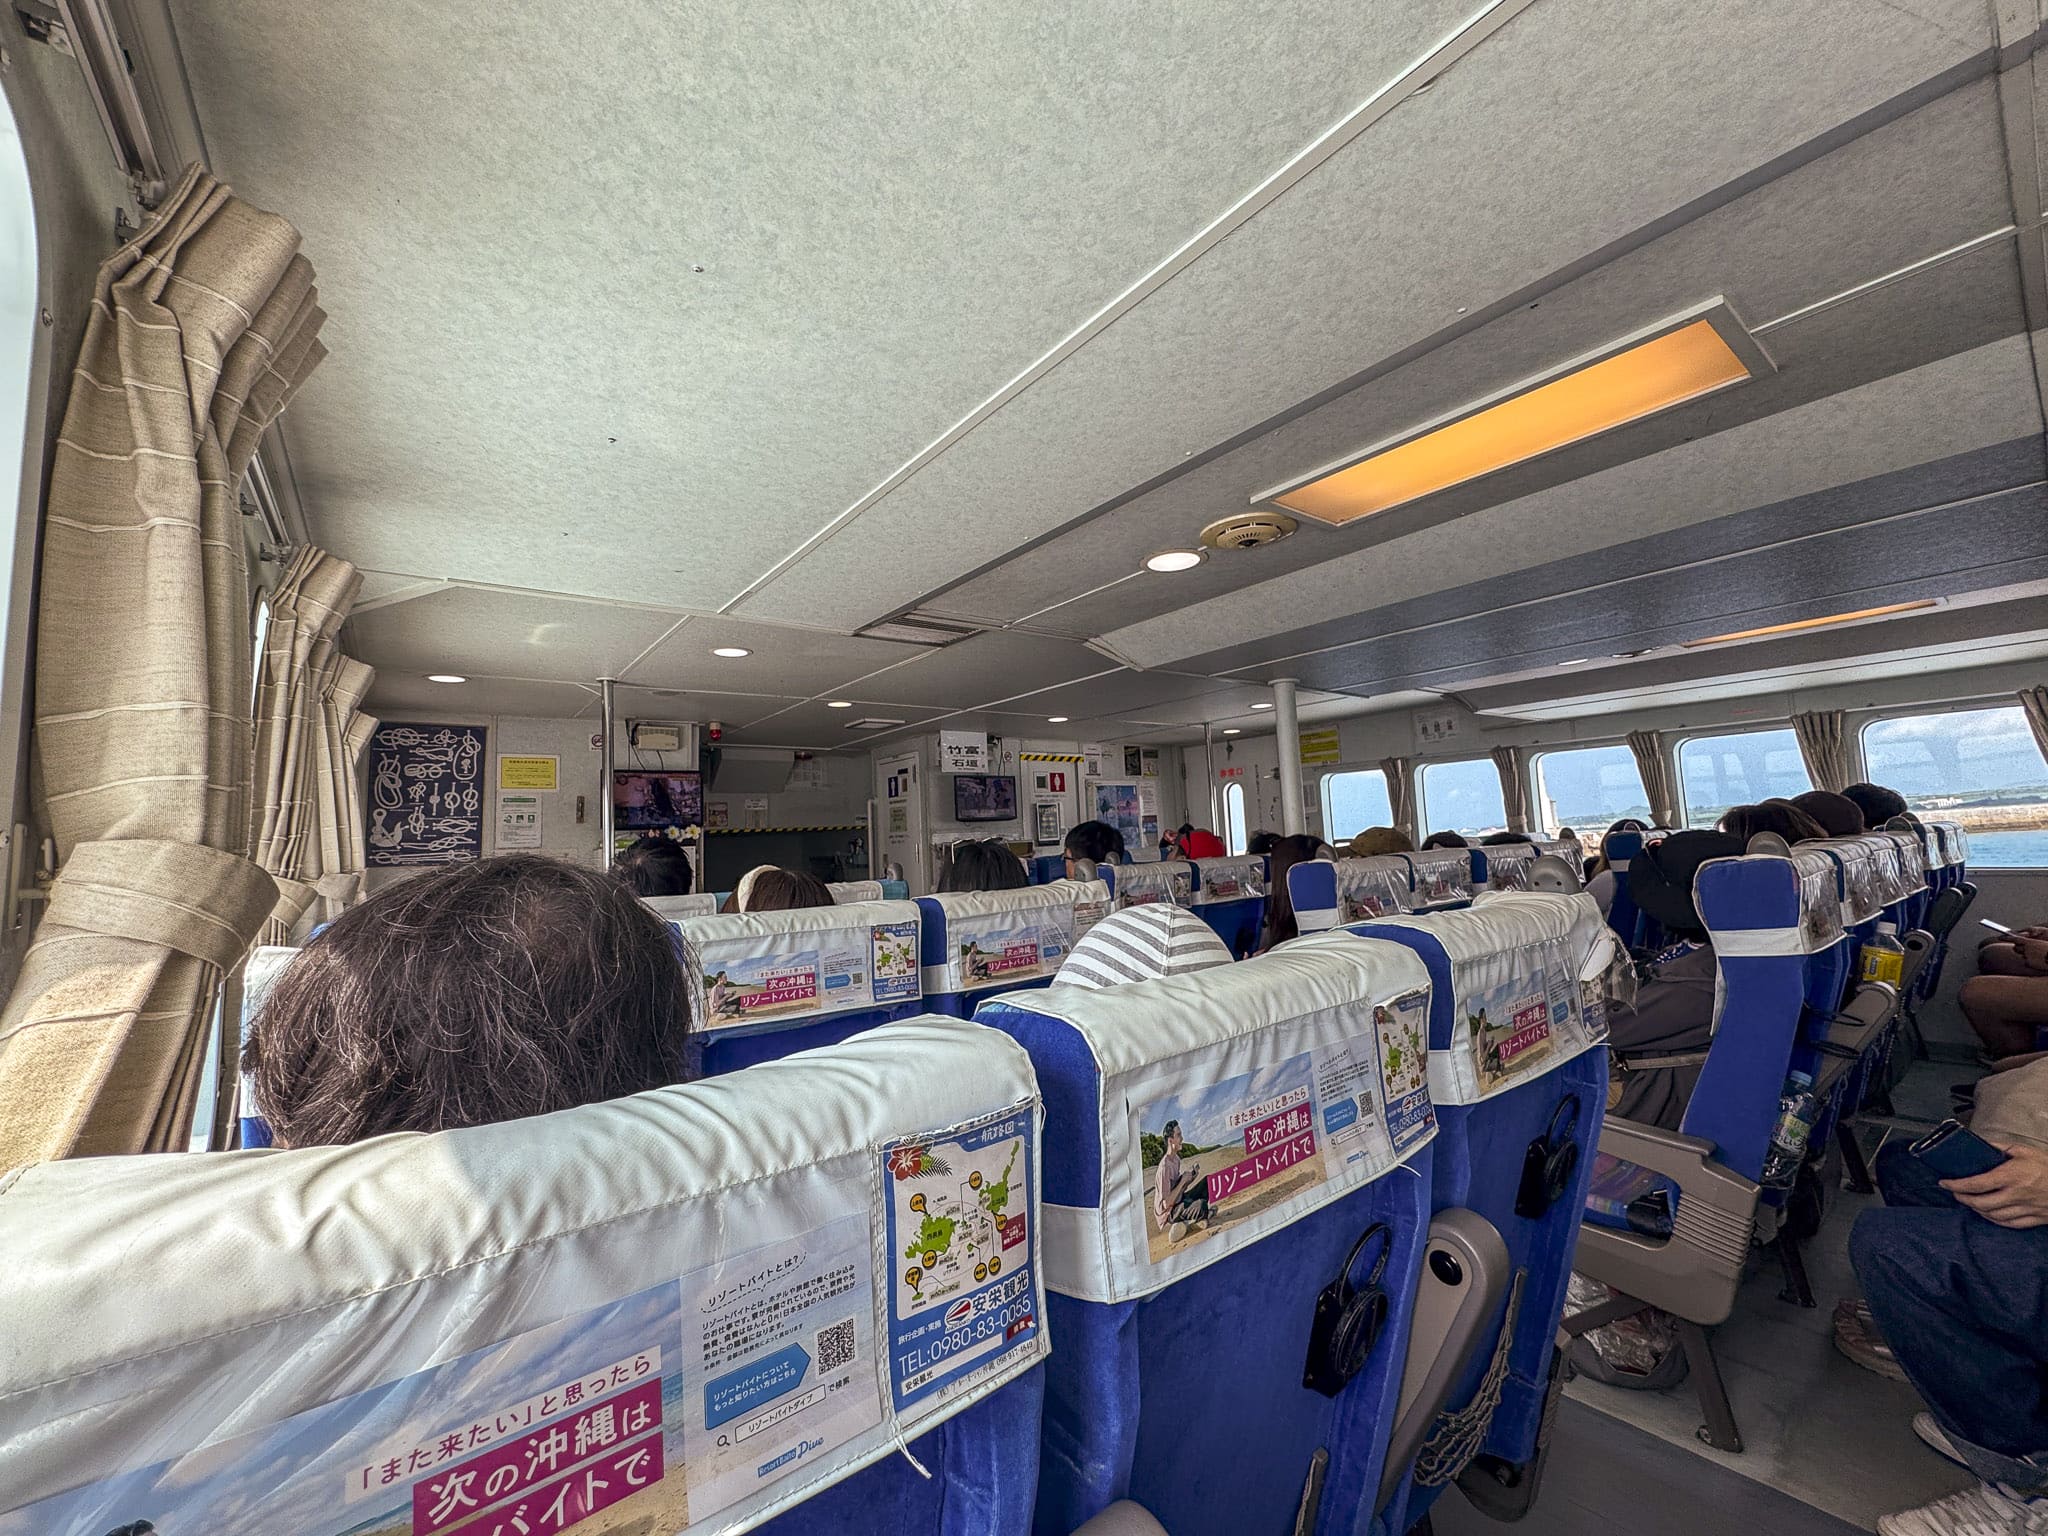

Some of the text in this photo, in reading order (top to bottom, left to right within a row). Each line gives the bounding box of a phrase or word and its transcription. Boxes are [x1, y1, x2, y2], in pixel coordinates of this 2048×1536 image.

[769, 976, 813, 989] 次の沖縄は
[988, 956, 1036, 970] リゾートバイトで
[742, 986, 814, 1006] リゾートバイトで
[1514, 1008, 1545, 1031] 次の沖縄は
[1500, 1023, 1547, 1058] リゾートバイトで
[1229, 1087, 1306, 1127] 「また来たい」と思ったら
[981, 1121, 1014, 1142] 航路図
[1249, 1111, 1309, 1150] 次の沖縄は
[1211, 1135, 1311, 1199] リゾートバイトで
[708, 1255, 799, 1307] リゾートバイトとは?
[972, 1270, 1029, 1316] 安栄観光
[899, 1294, 1031, 1377] TEL:0980-83-0055
[714, 1361, 790, 1401] リゾートバイトについて
[714, 1367, 797, 1412] もっと知りたい方はこちら
[828, 1376, 850, 1392] で検索
[905, 1371, 934, 1392] 安栄観光
[362, 1355, 651, 1489] 「また来たい」と思ったら
[748, 1393, 813, 1433] リゾートバイトダイブ
[428, 1401, 651, 1526] 次の沖縄は
[797, 1437, 824, 1459] Dive
